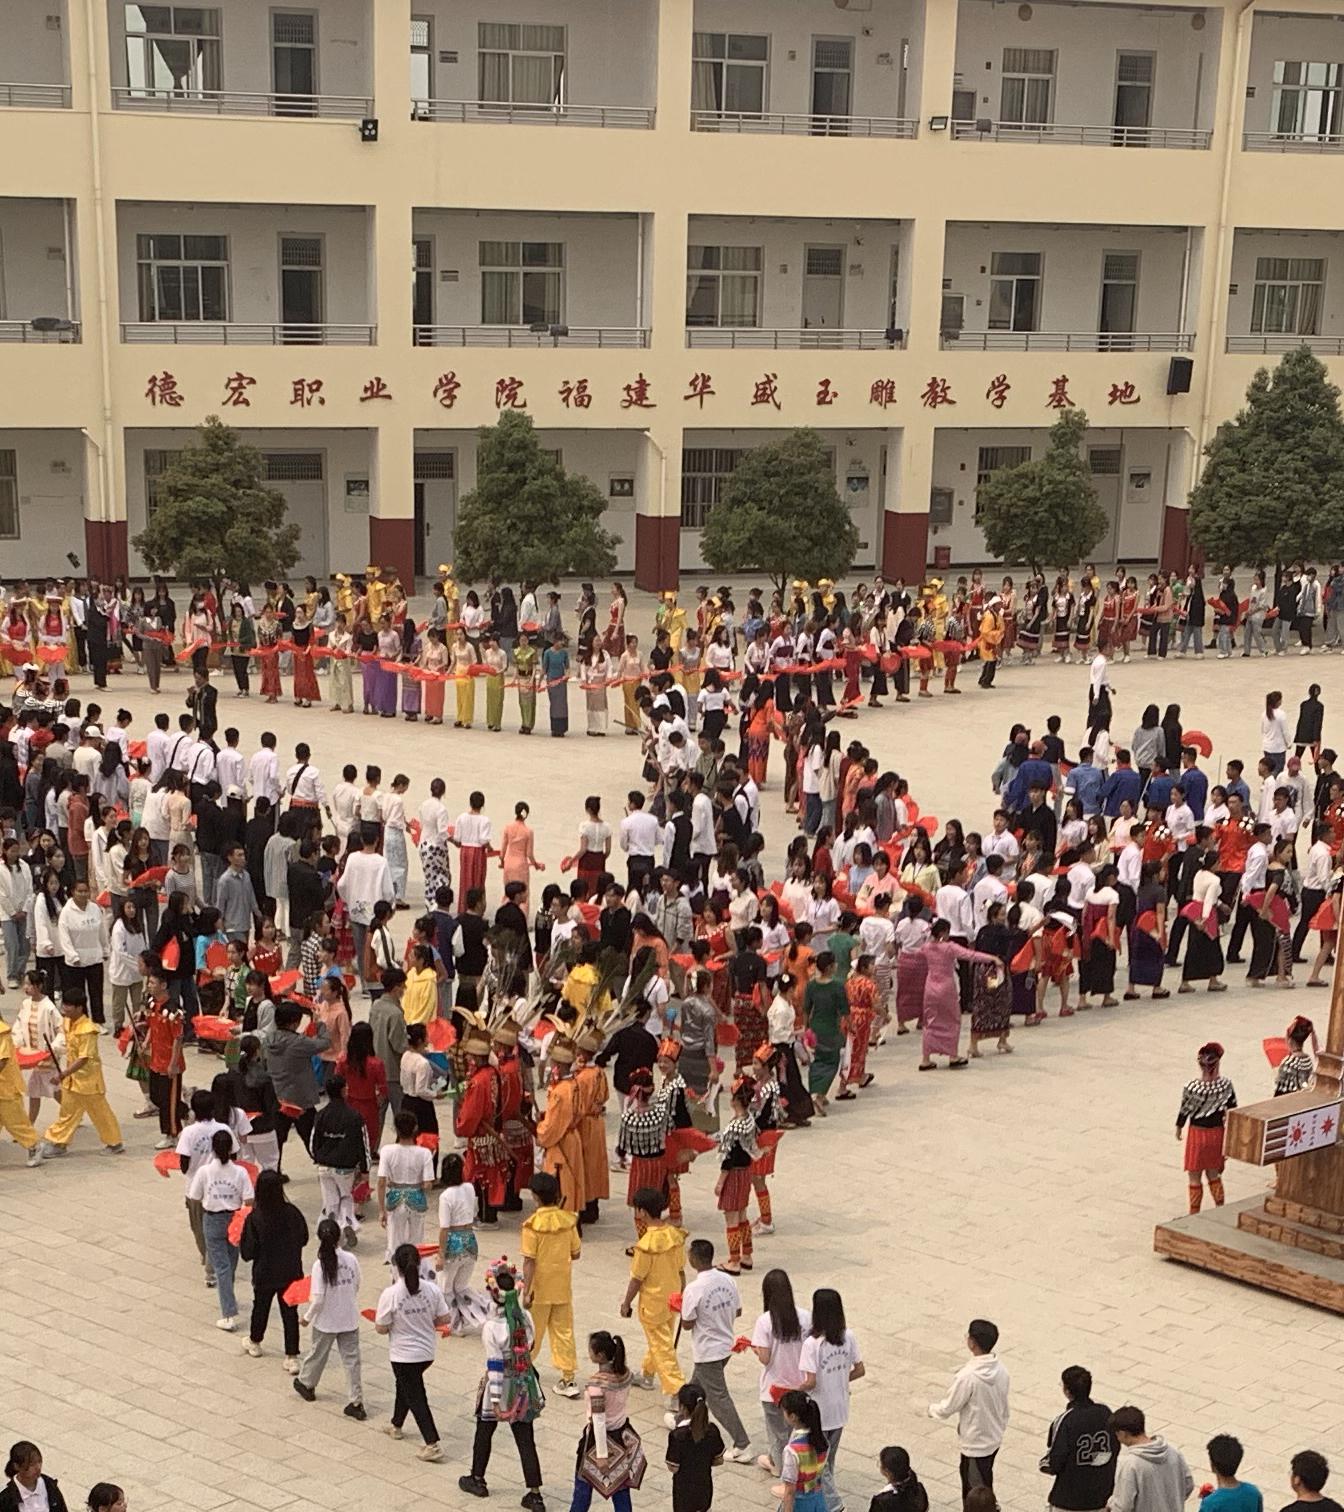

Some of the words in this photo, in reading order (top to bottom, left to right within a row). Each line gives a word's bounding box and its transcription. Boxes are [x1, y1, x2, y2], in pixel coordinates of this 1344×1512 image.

[145, 371, 1141, 411] 德宏职业学院福建华盛玉雕教学基地
